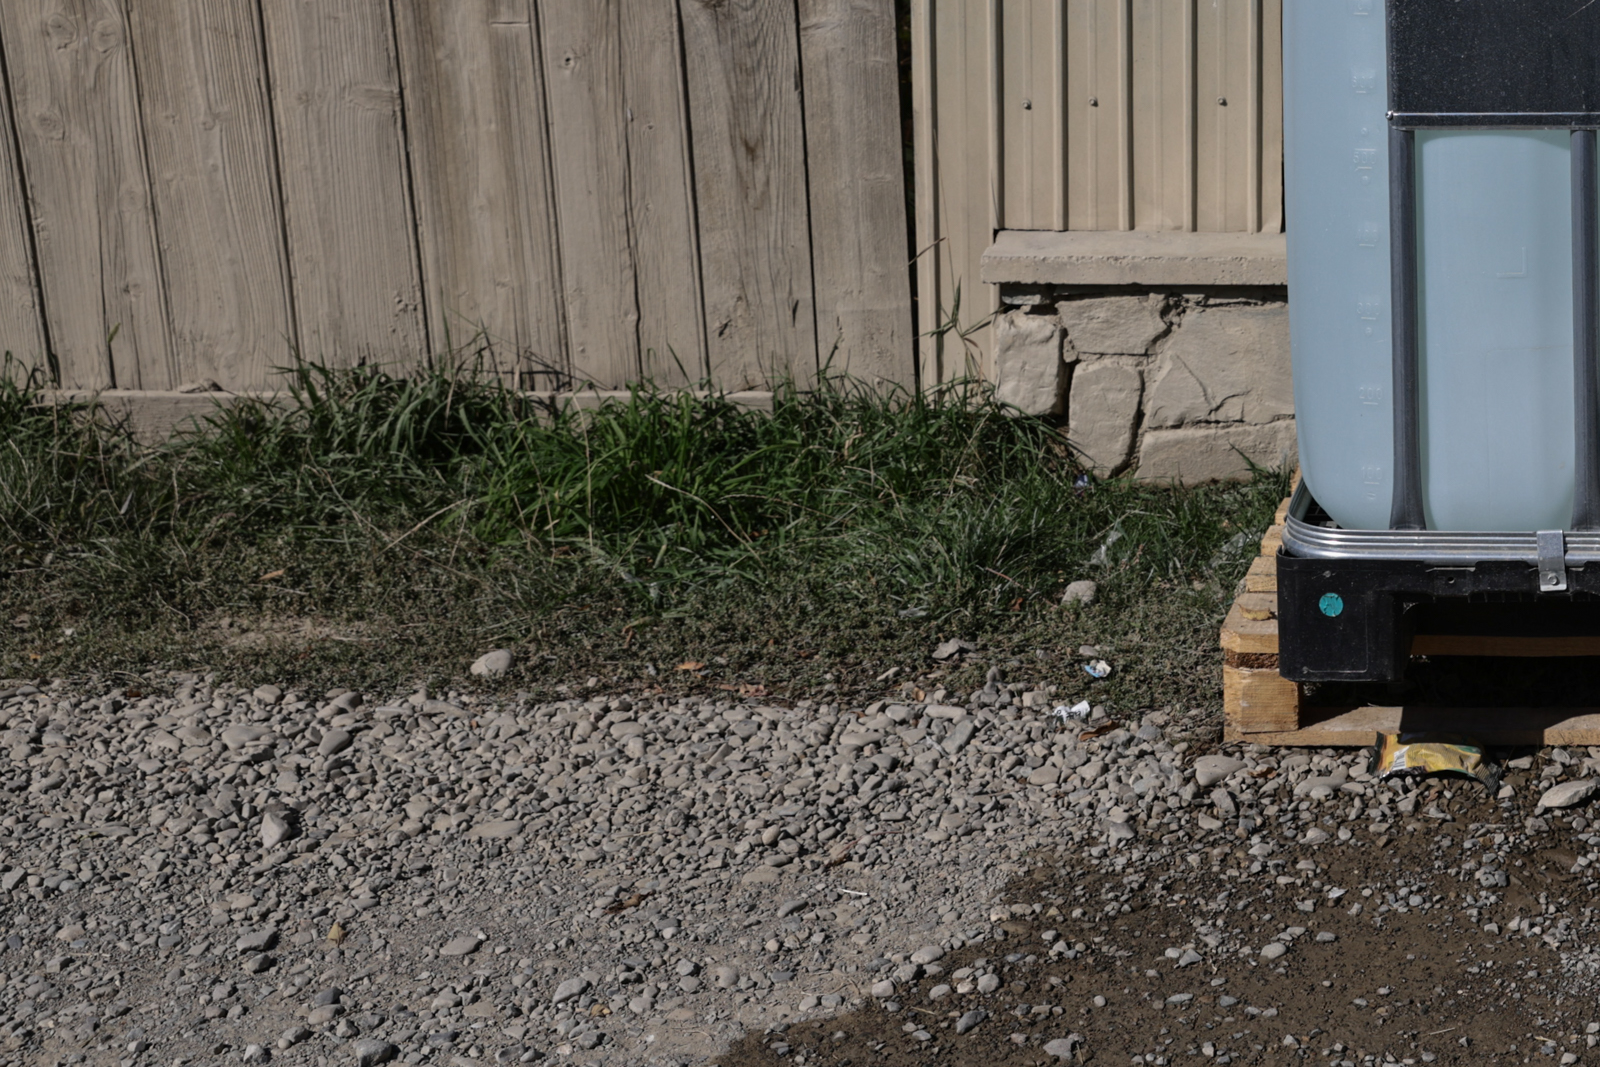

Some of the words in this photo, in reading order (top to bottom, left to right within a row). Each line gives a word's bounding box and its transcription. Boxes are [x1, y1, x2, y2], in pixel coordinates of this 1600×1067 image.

[1352, 151, 1377, 164] 500
[1358, 387, 1384, 400] 200
[1360, 467, 1384, 480] 100
